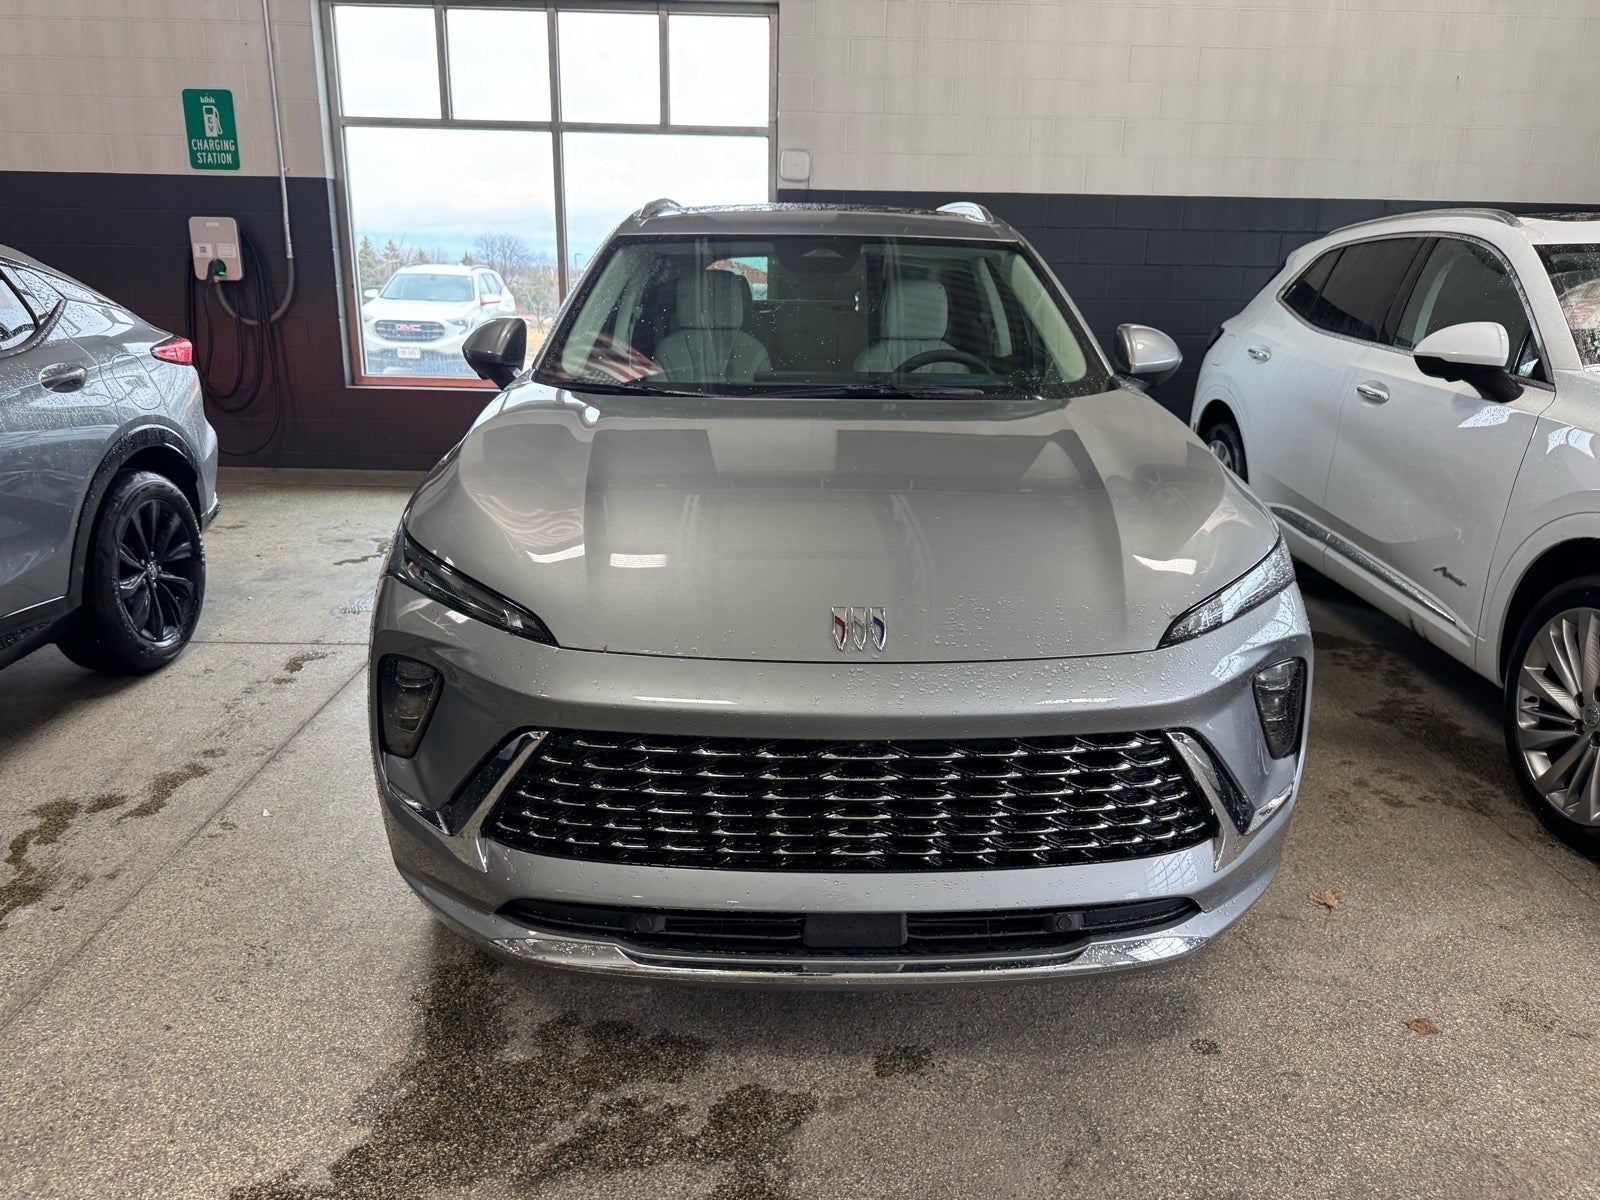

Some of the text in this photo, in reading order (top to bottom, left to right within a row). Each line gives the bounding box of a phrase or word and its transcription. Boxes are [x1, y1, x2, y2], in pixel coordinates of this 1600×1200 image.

[191, 138, 235, 151] CHARGING
[197, 152, 232, 164] STATION
[395, 323, 421, 332] GMC
